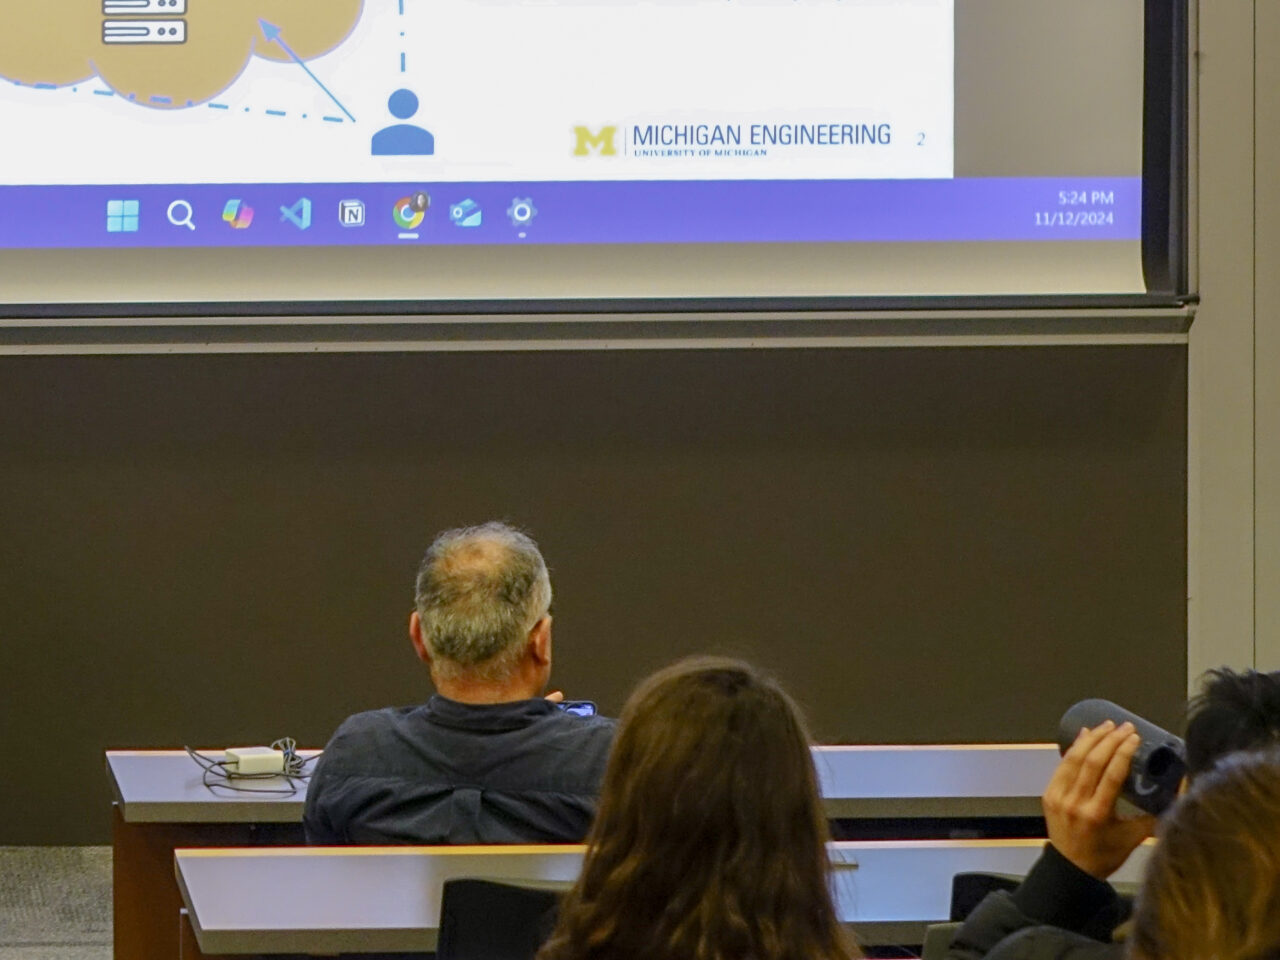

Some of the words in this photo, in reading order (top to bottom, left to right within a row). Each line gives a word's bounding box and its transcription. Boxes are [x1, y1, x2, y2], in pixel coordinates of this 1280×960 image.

[632, 124, 742, 146] MICHIGAN
[749, 123, 892, 146] ENGINEERING
[916, 132, 927, 147] 2
[633, 148, 696, 158] UNIVERSITY
[698, 148, 712, 158] OF
[714, 147, 768, 158] MICHIGAN
[1058, 191, 1088, 205] 5:24
[1091, 190, 1115, 205] PM
[1034, 211, 1114, 227] 11/12/2024
